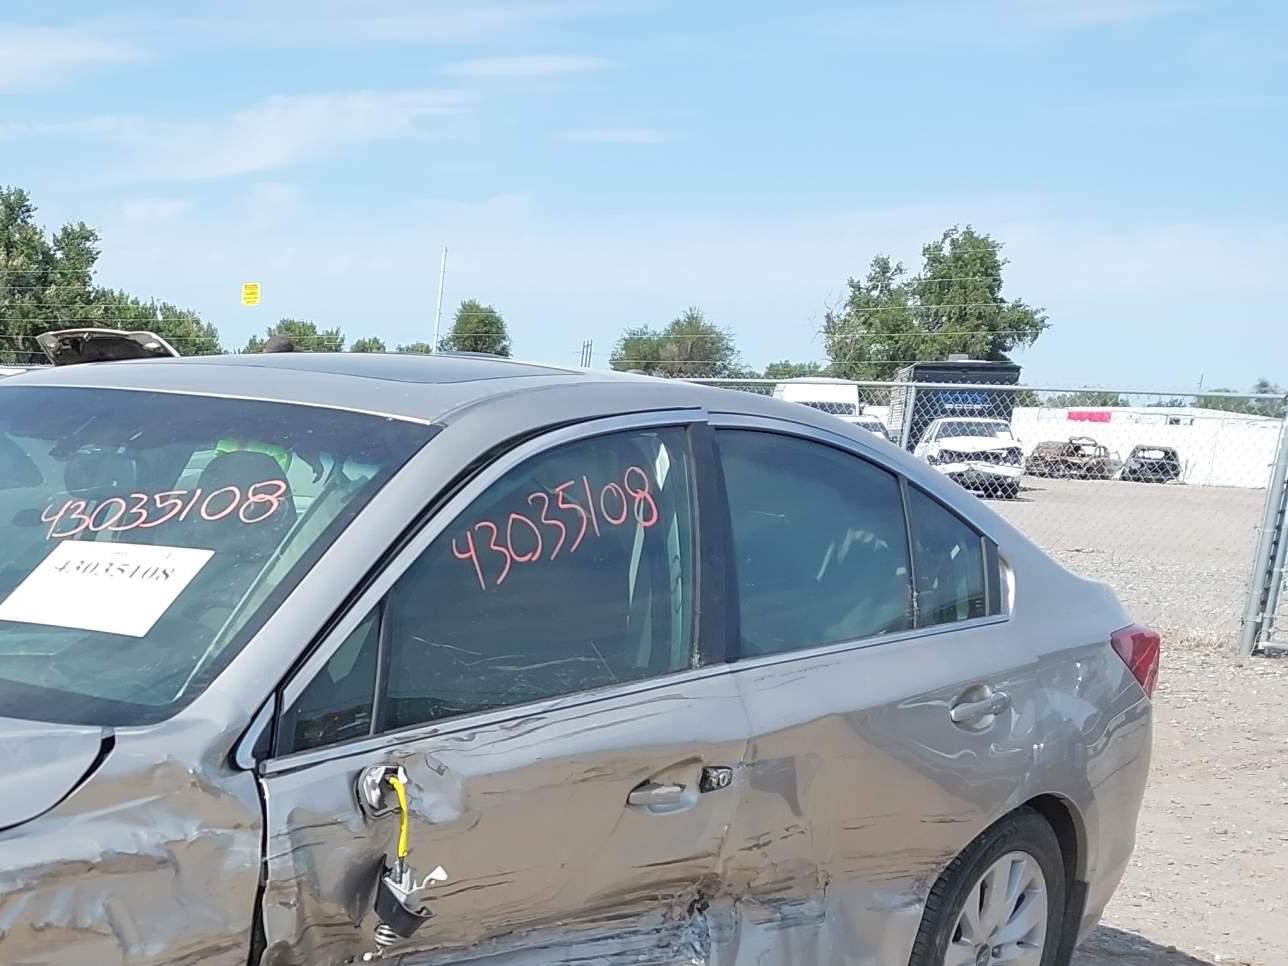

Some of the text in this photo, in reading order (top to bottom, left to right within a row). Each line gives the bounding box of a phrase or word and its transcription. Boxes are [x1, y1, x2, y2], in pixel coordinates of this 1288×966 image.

[41, 480, 287, 541] 43035108
[452, 466, 658, 590] 43035108
[53, 559, 176, 582] 43035108
